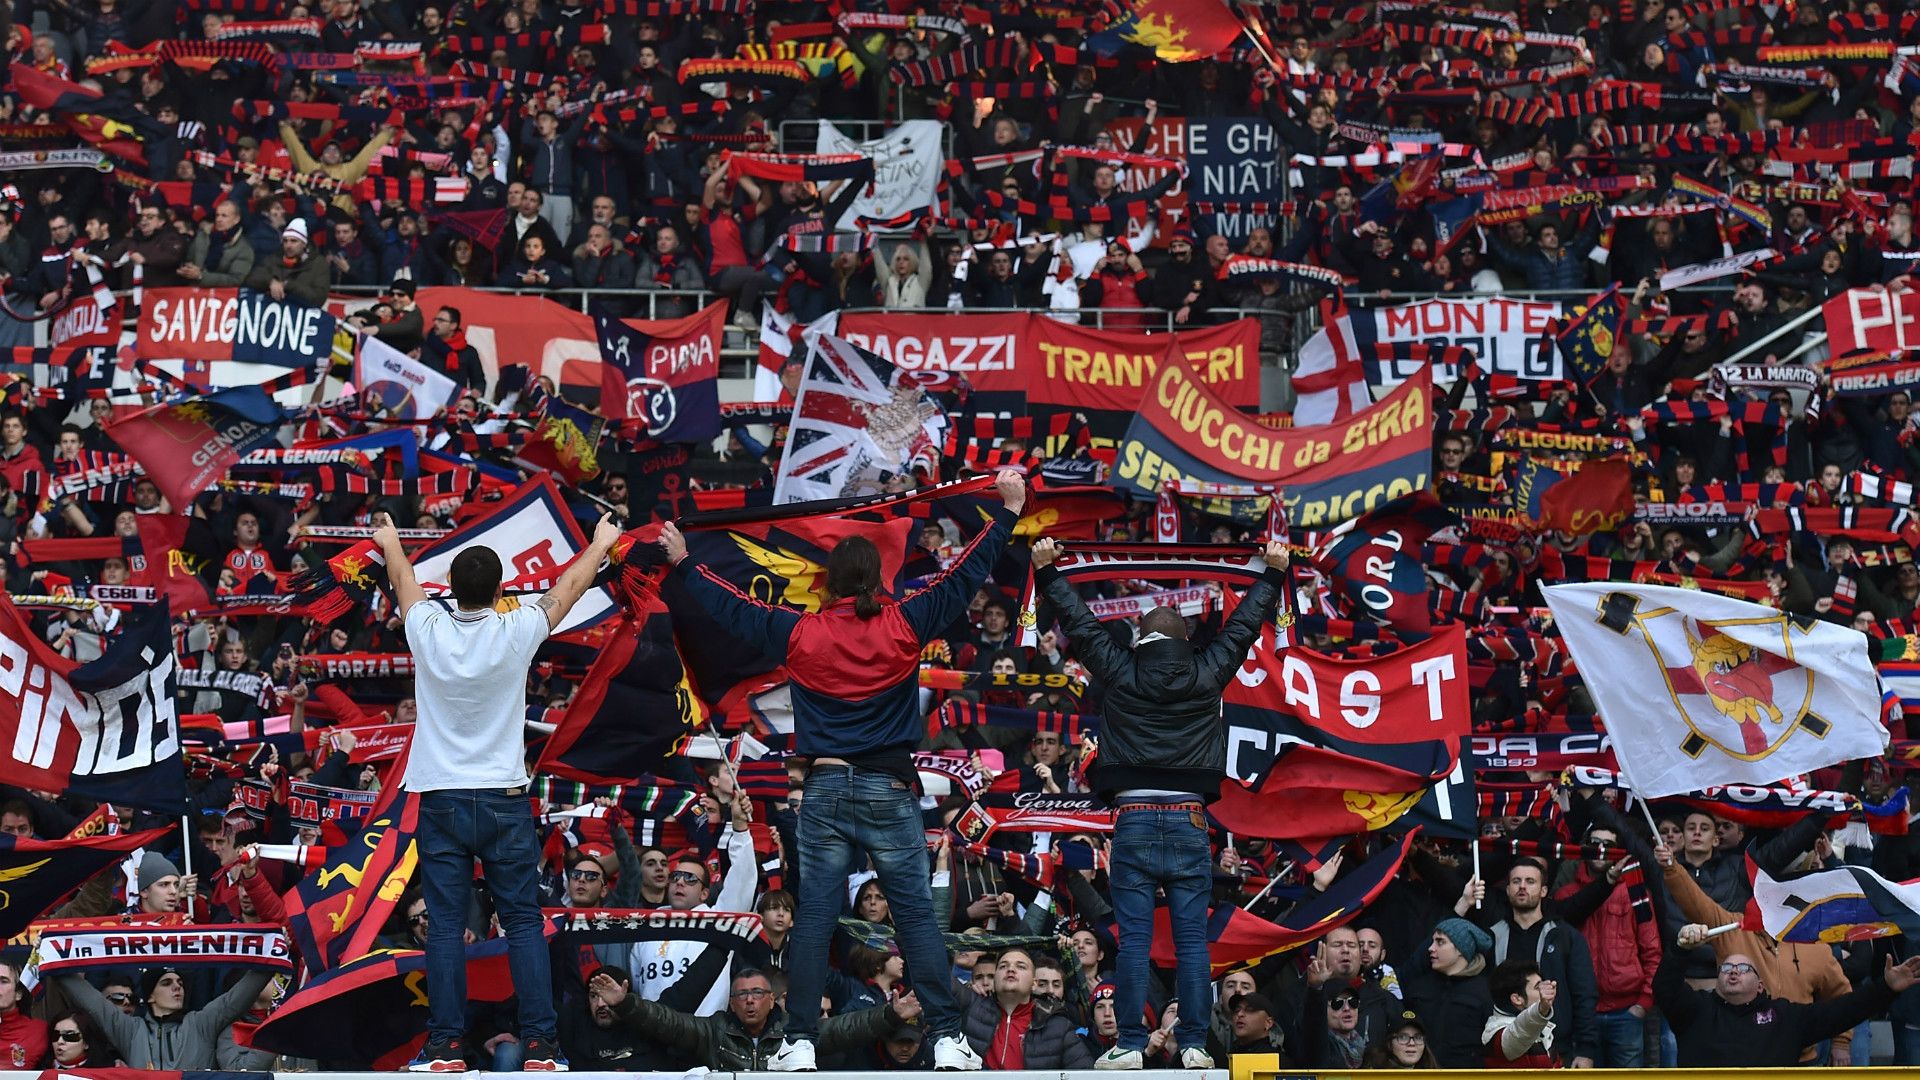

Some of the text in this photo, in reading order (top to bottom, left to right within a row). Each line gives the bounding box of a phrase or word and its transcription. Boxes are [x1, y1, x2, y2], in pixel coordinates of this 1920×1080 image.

[1203, 158, 1280, 195] NIÂT
[150, 298, 322, 356] SAVIGNONE
[1385, 300, 1555, 338] MONTE
[1746, 367, 1763, 381] LA
[1833, 374, 1887, 391] FORZA
[1157, 365, 1426, 472] CIUCCHI da BIRA
[191, 420, 258, 467] GENOA
[1518, 432, 1594, 452] LIGURI
[282, 449, 341, 464] GENOA
[327, 658, 391, 679] FORZA
[354, 732, 388, 749] ricket
[1486, 757, 1538, 767] 1893
[1006, 792, 1092, 820] Genoa
[649, 912, 758, 943] GRIFONI
[103, 934, 264, 957] ARMENIA
